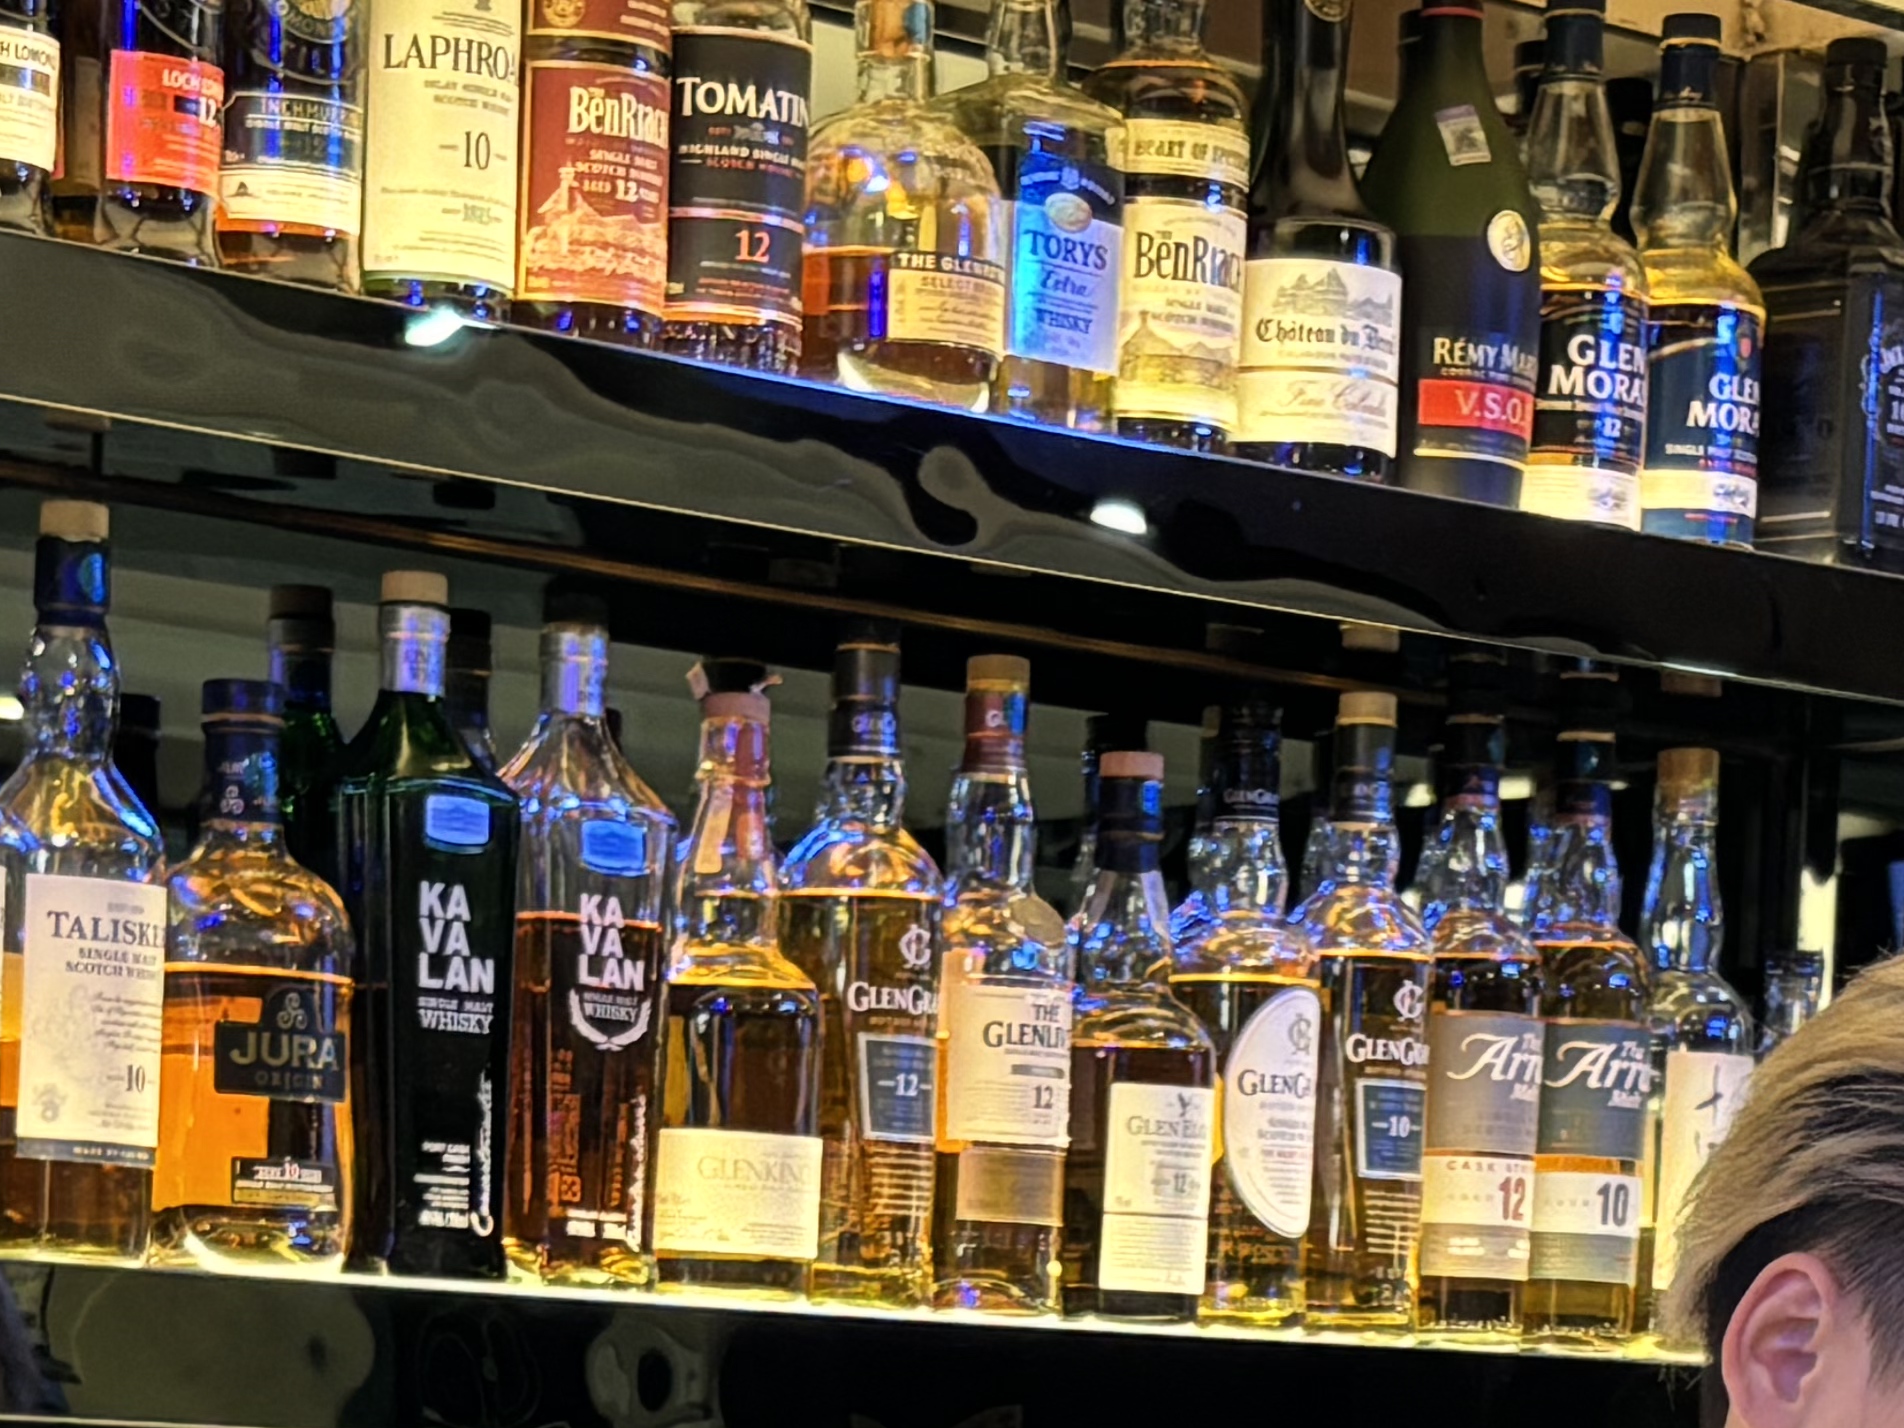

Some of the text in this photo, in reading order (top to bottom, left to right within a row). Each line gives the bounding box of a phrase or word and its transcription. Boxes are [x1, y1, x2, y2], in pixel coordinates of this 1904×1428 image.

[198, 96, 217, 127] 12
[463, 130, 491, 171] 10
[615, 179, 638, 203] 12
[734, 229, 770, 264] 12
[1025, 228, 1109, 272] TORYS
[1547, 364, 1646, 402] MORA
[417, 880, 472, 921] KA
[579, 892, 625, 929] KA
[418, 917, 471, 957] VA
[579, 924, 624, 959] VA
[417, 954, 495, 995] LAN
[578, 954, 645, 992] LAN
[418, 1007, 494, 1036] WHISKY
[582, 1000, 639, 1025] WHISKY
[1031, 1003, 1061, 1023] THE
[229, 1030, 341, 1071] JURA
[124, 1063, 147, 1095] 10
[896, 1073, 920, 1099] 12
[1033, 1085, 1054, 1110] 12
[1388, 1116, 1411, 1139] 10
[1498, 1175, 1528, 1222] 12
[1596, 1180, 1630, 1227] 10
